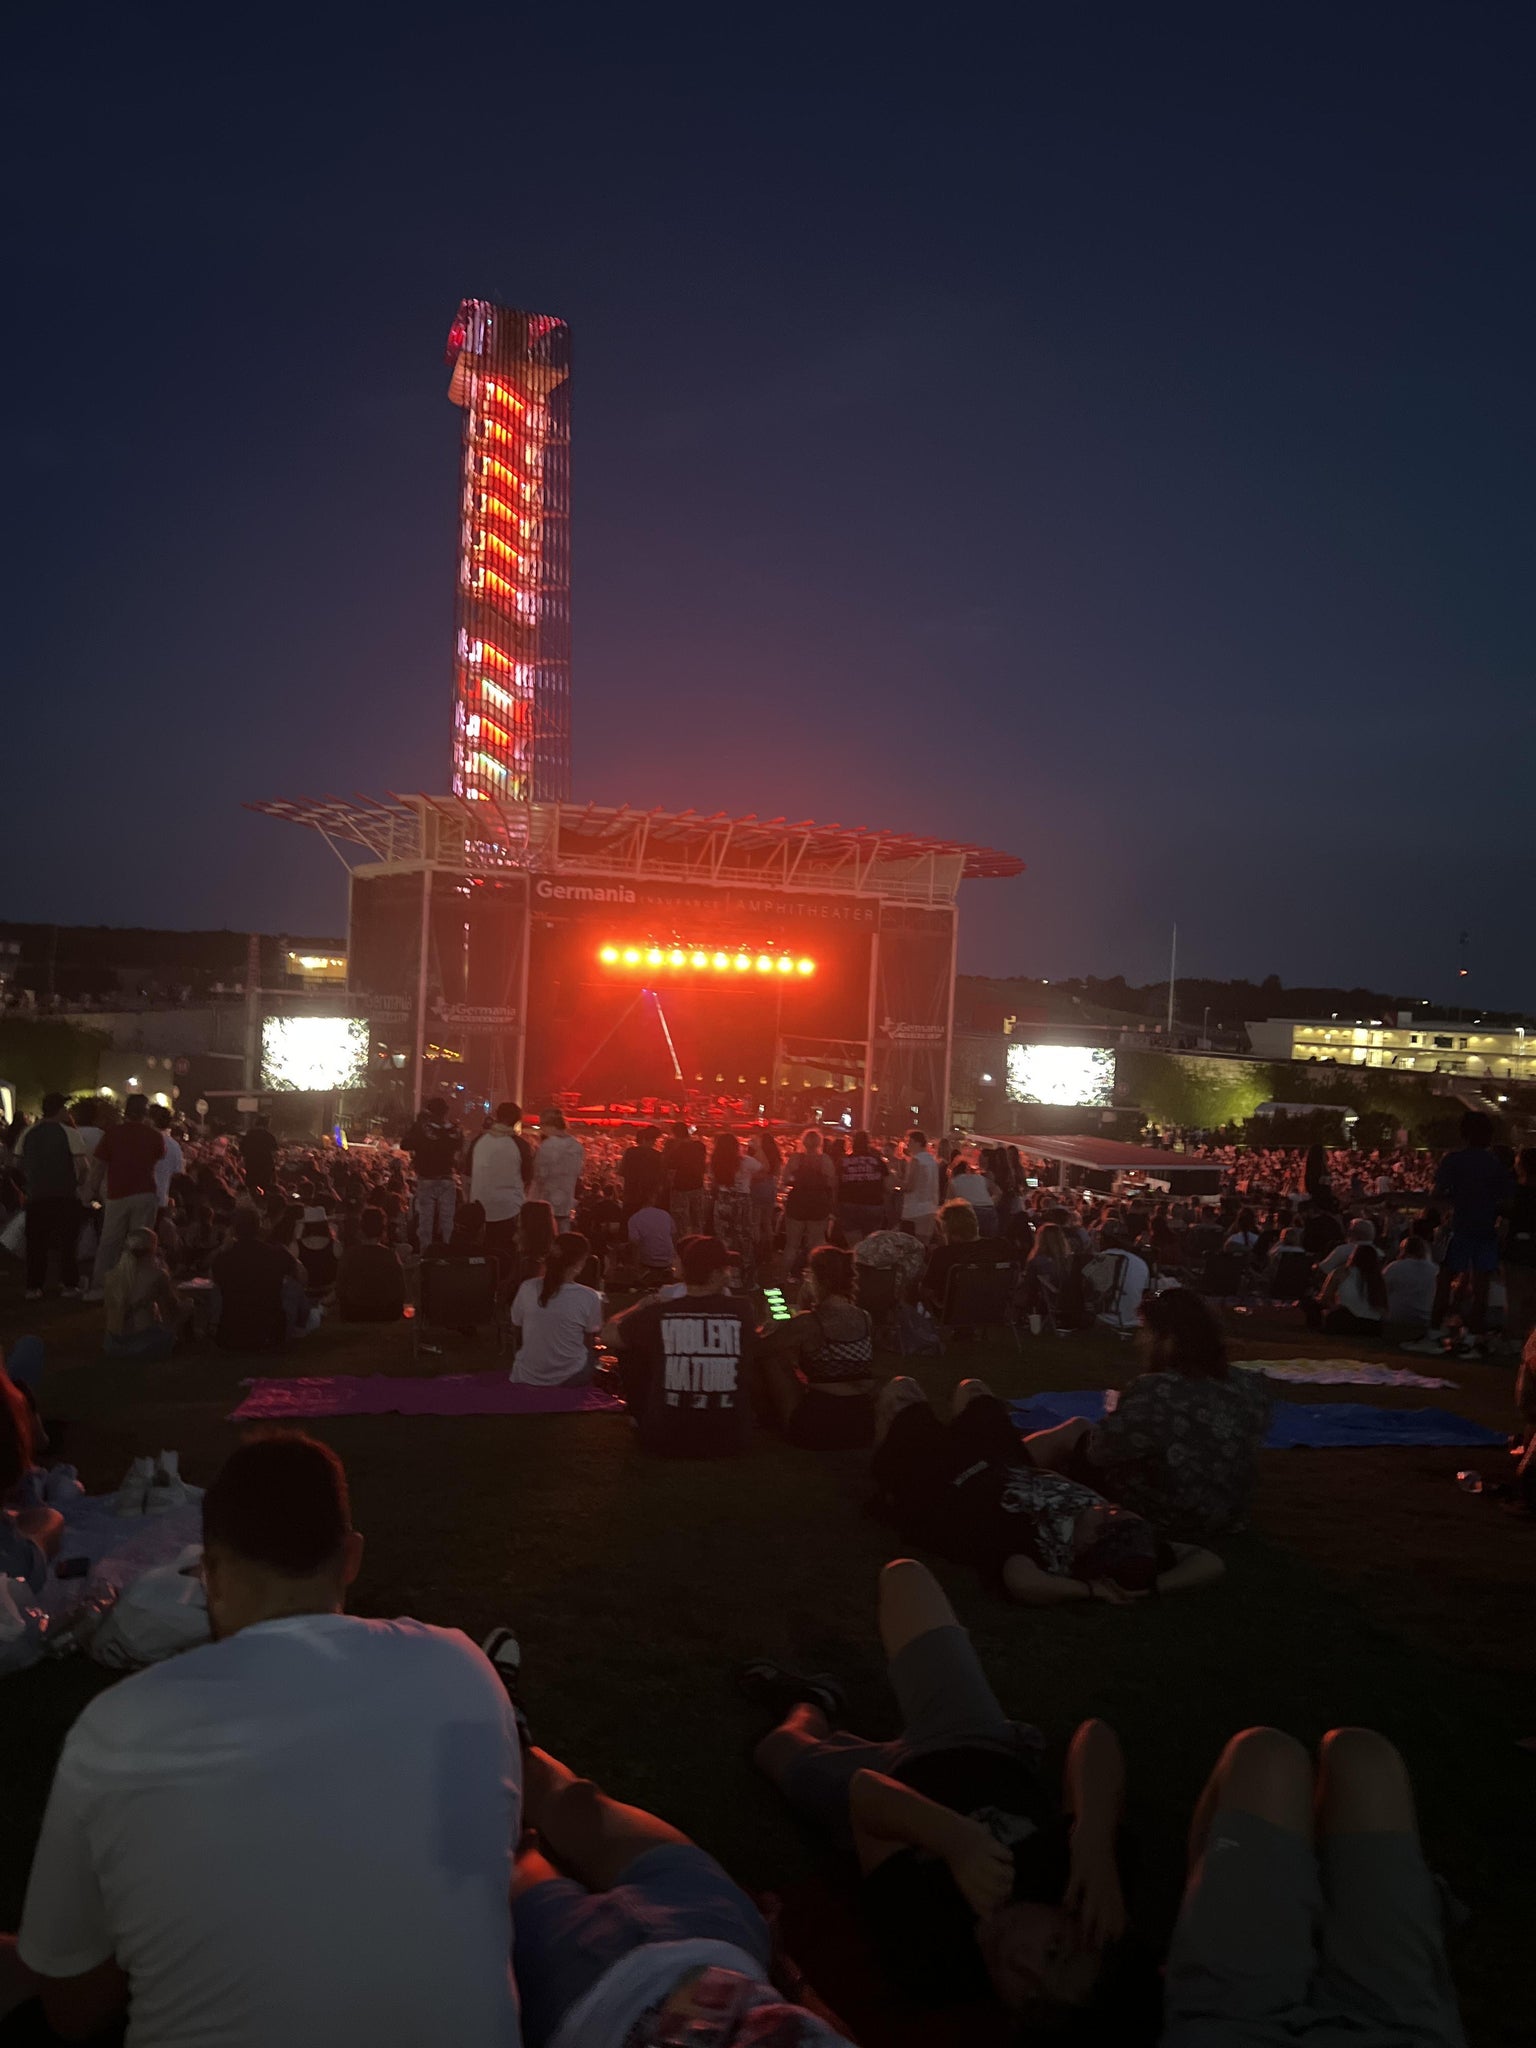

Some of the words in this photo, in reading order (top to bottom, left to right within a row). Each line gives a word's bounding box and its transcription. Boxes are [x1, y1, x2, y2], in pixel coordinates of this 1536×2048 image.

[536, 880, 636, 903] Germania
[738, 900, 874, 920] AMPHITHEATER
[456, 1002, 516, 1016] Germania
[661, 1319, 742, 1354] VIOLENT
[664, 1356, 738, 1391] NATURE
